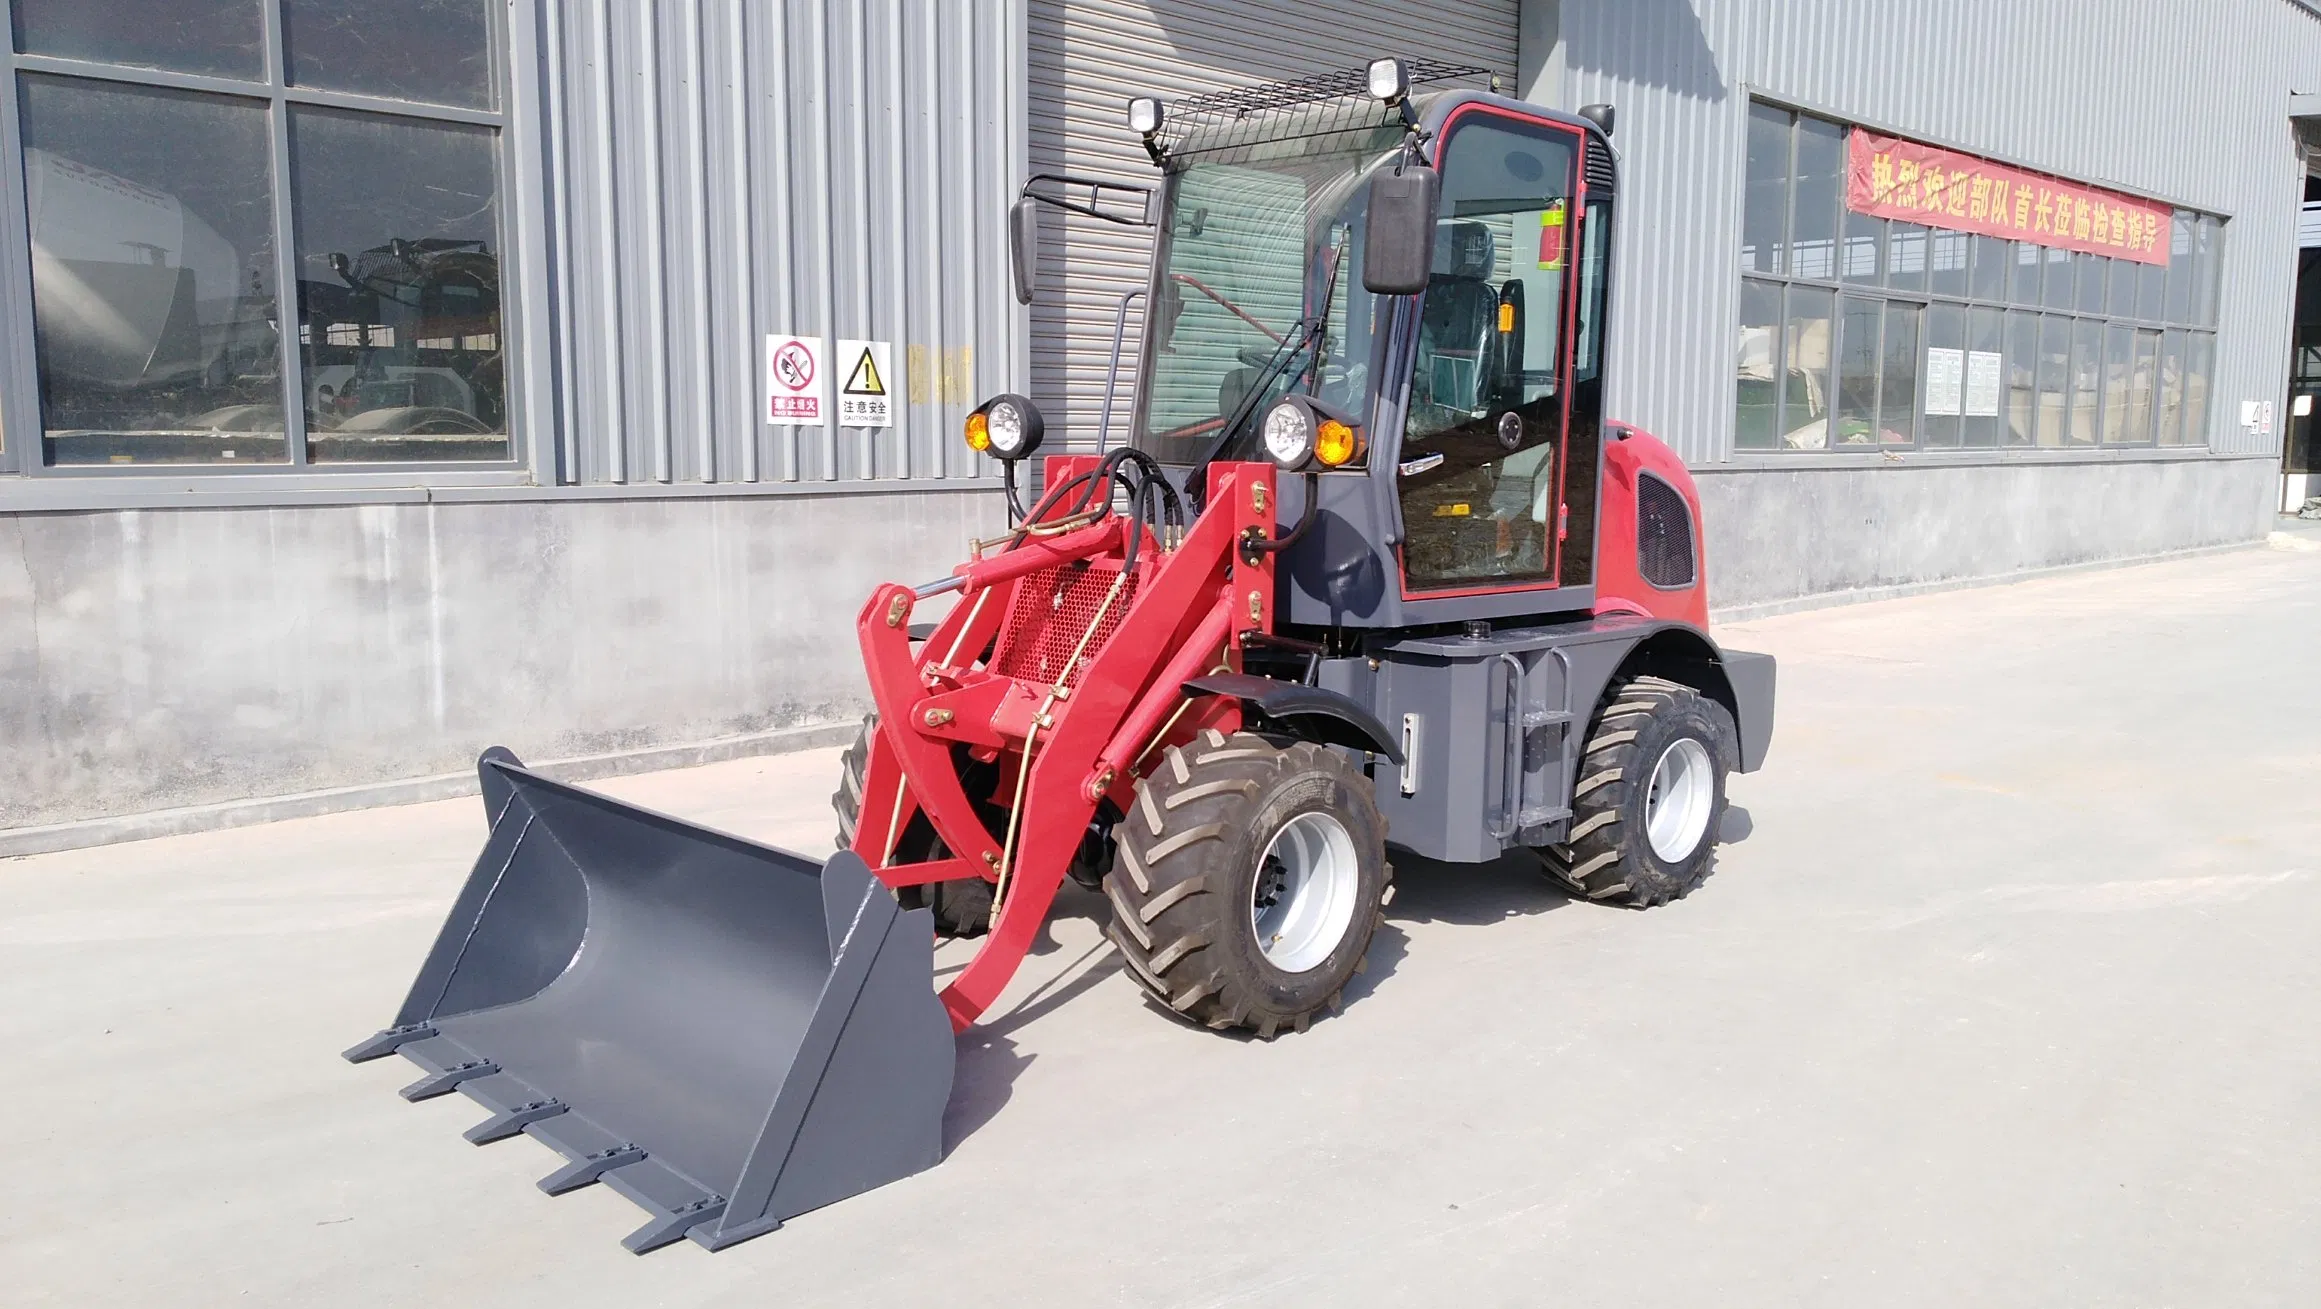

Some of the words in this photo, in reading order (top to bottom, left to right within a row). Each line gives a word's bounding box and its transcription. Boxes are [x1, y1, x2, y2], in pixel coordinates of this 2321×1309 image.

[1872, 153, 2157, 253] 热烈欢迎部队首长莅临检查指导
[843, 400, 886, 414] 注意安全
